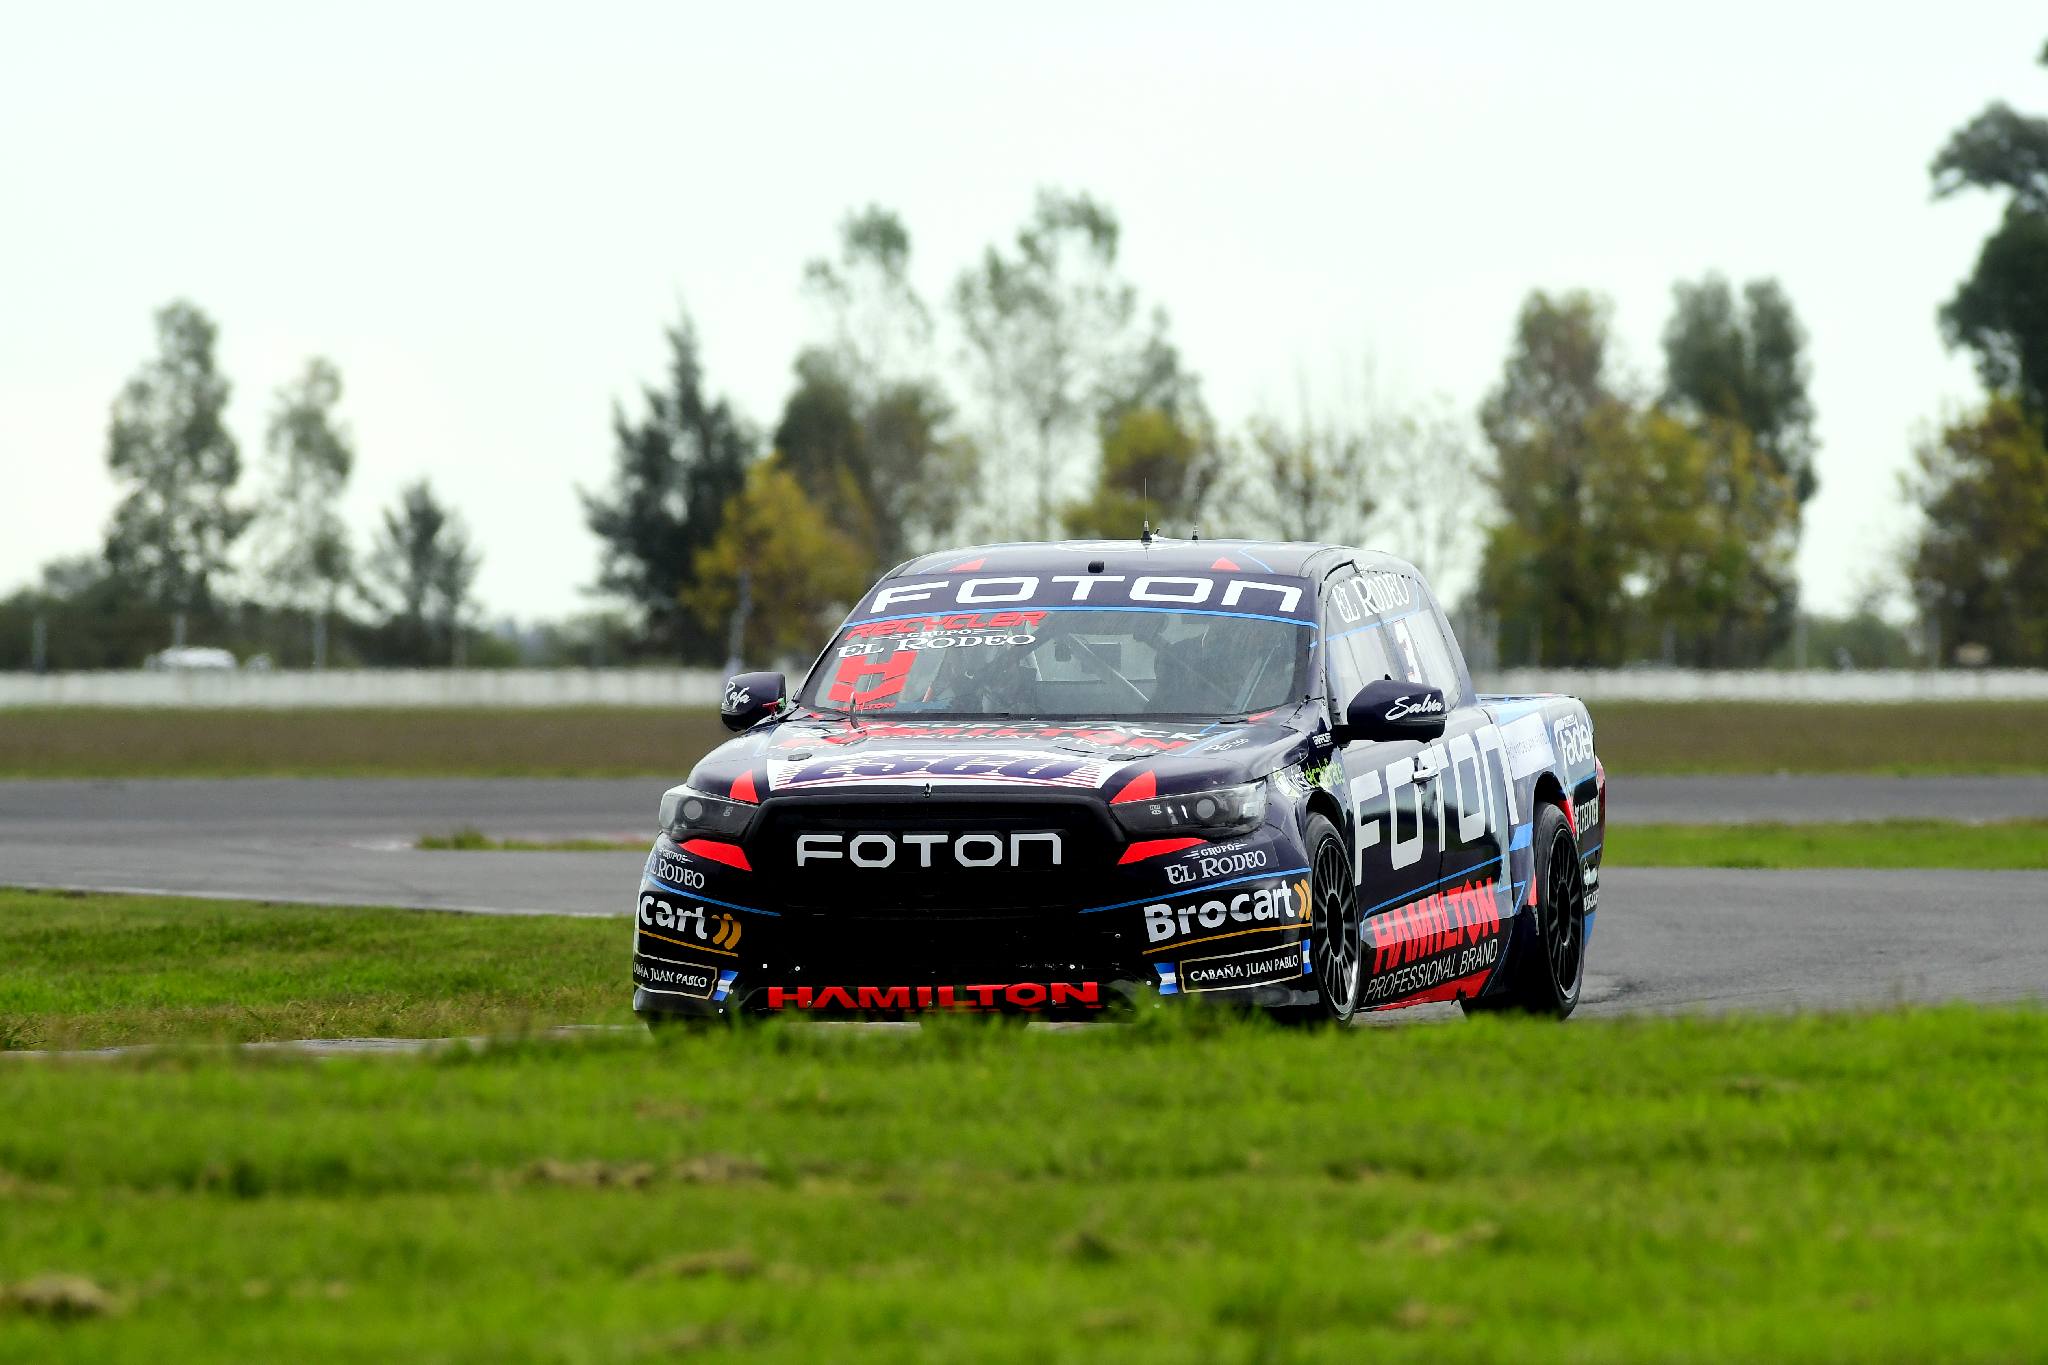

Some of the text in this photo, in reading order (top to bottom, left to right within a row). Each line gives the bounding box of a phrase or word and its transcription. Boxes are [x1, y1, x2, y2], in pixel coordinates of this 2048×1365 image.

[870, 575, 1303, 613] FOTON
[1331, 584, 1361, 624] EL
[837, 634, 1036, 658] EL RODEO
[907, 629, 972, 638] GRUPO
[1384, 694, 1443, 721] Salva
[1350, 724, 1519, 887] FOTON
[796, 832, 1061, 869] FOTON
[1201, 843, 1235, 857] GRUPO
[658, 858, 705, 889] RODEO
[1164, 850, 1267, 885] EL RODEO
[1143, 880, 1295, 942] Brocart
[1371, 877, 1500, 974] HAMILTON
[649, 967, 674, 983] JUAN
[676, 973, 707, 988] PABLO
[1190, 954, 1299, 982] CABAÑA JUAN PABLO
[1364, 938, 1498, 1003] PROFESSIONAL BRAND
[768, 982, 1098, 1008] HAMILTON
